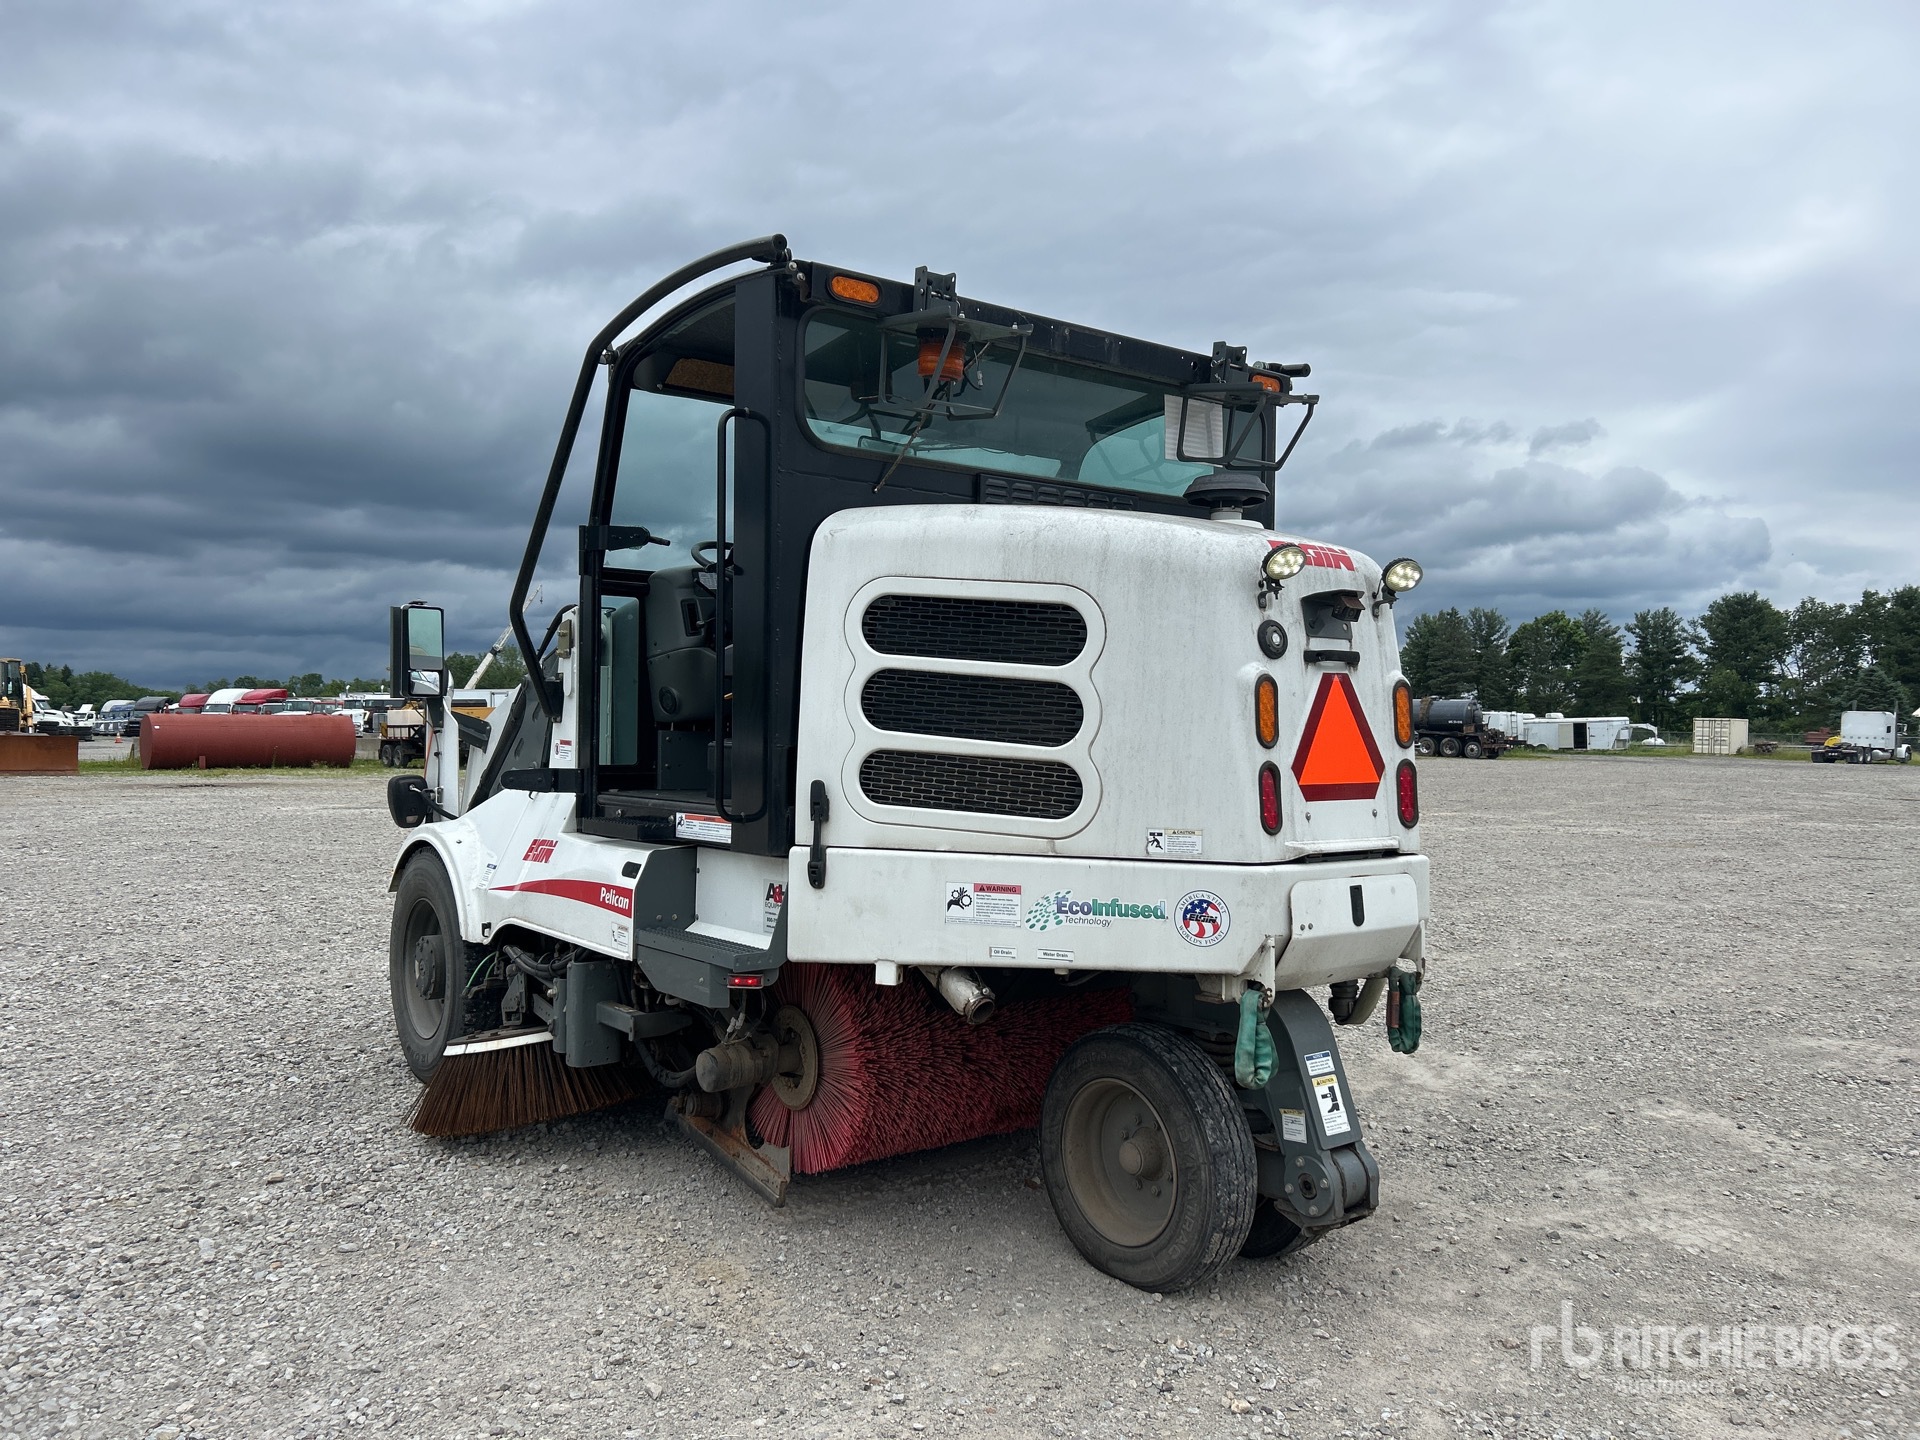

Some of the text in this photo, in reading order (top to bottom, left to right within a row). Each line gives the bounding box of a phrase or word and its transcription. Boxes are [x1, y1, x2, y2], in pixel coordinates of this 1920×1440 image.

[1267, 540, 1355, 571] GIN
[600, 887, 629, 910] Pelican
[986, 885, 1017, 894] WARNING
[1179, 893, 1226, 914] AMERICA'S FIRST
[1064, 915, 1112, 928] Technology
[1188, 913, 1217, 924] ELGIN
[1179, 925, 1225, 944] WORLD'S FINEST
